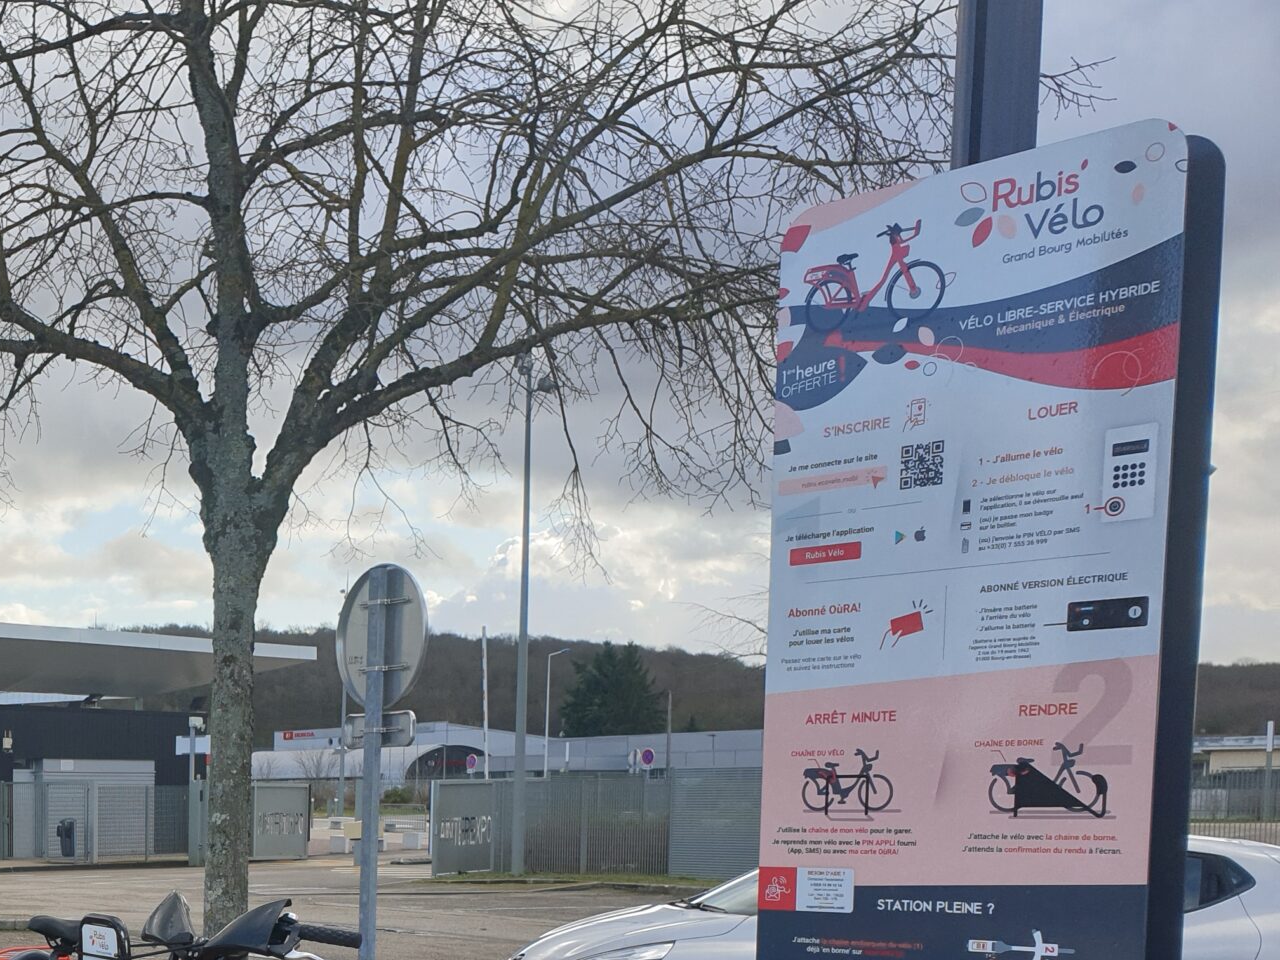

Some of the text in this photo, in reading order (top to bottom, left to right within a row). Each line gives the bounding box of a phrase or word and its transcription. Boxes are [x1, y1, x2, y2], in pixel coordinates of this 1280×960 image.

[1024, 198, 1104, 239] Vélo
[1002, 228, 1128, 264] Grand Bourg Mobilités
[959, 280, 1160, 330] VÉLO LIBRE-SERVICE HYBRIDE
[996, 303, 1125, 336] Mécanique & Électrique
[796, 360, 835, 380] heure
[781, 371, 837, 398] OFFERTE
[1028, 401, 1079, 421] LOUER
[823, 416, 891, 438] S'INSCRIRE
[798, 463, 809, 471] me
[810, 459, 842, 470] connecte
[843, 457, 855, 465] sur
[856, 454, 863, 463] le
[864, 453, 878, 462] site
[992, 453, 1031, 464] J'allume
[1032, 450, 1042, 458] le
[1043, 445, 1064, 456] vélo
[971, 479, 978, 488] 2
[999, 471, 1041, 484] débloque
[1043, 468, 1052, 477] le
[1054, 466, 1075, 476] vélo
[1084, 503, 1090, 514] 1
[795, 530, 831, 541] télécharge
[832, 525, 874, 537] l'application
[805, 550, 827, 560] Rubis
[980, 572, 1129, 593] ABONNÉ VERSION ÉLECTRIQUE
[788, 605, 826, 618] Abonné
[832, 626, 851, 634] carte
[788, 639, 804, 648] pour
[1018, 702, 1079, 717] RENDRE
[805, 710, 897, 725] ARRÊT MINUTE
[1004, 739, 1017, 747] DE
[1016, 739, 1044, 747] BORNE
[817, 749, 826, 757] DU
[828, 748, 846, 757] VÉLO
[854, 826, 869, 834] vélo
[869, 828, 885, 836] pour
[893, 828, 913, 836] garer.
[968, 832, 1000, 840] J'attache
[1001, 832, 1008, 840] le
[1009, 832, 1025, 840] vélo
[1026, 833, 1044, 841] avec
[1081, 833, 1092, 841] de
[781, 839, 808, 848] reprends
[823, 838, 838, 846] vélo
[854, 839, 861, 847] le
[861, 839, 874, 847] PIN
[875, 839, 896, 847] APPLI
[897, 839, 917, 847] fourni
[963, 845, 994, 853] J'attends
[1004, 845, 1051, 854] confirmation
[1052, 846, 1063, 854] du
[1064, 846, 1087, 854] rendu
[1088, 846, 1094, 854] à
[876, 898, 996, 915] STATION PLEINE ?
[852, 948, 863, 956] sur
[1044, 946, 1055, 954] 2
